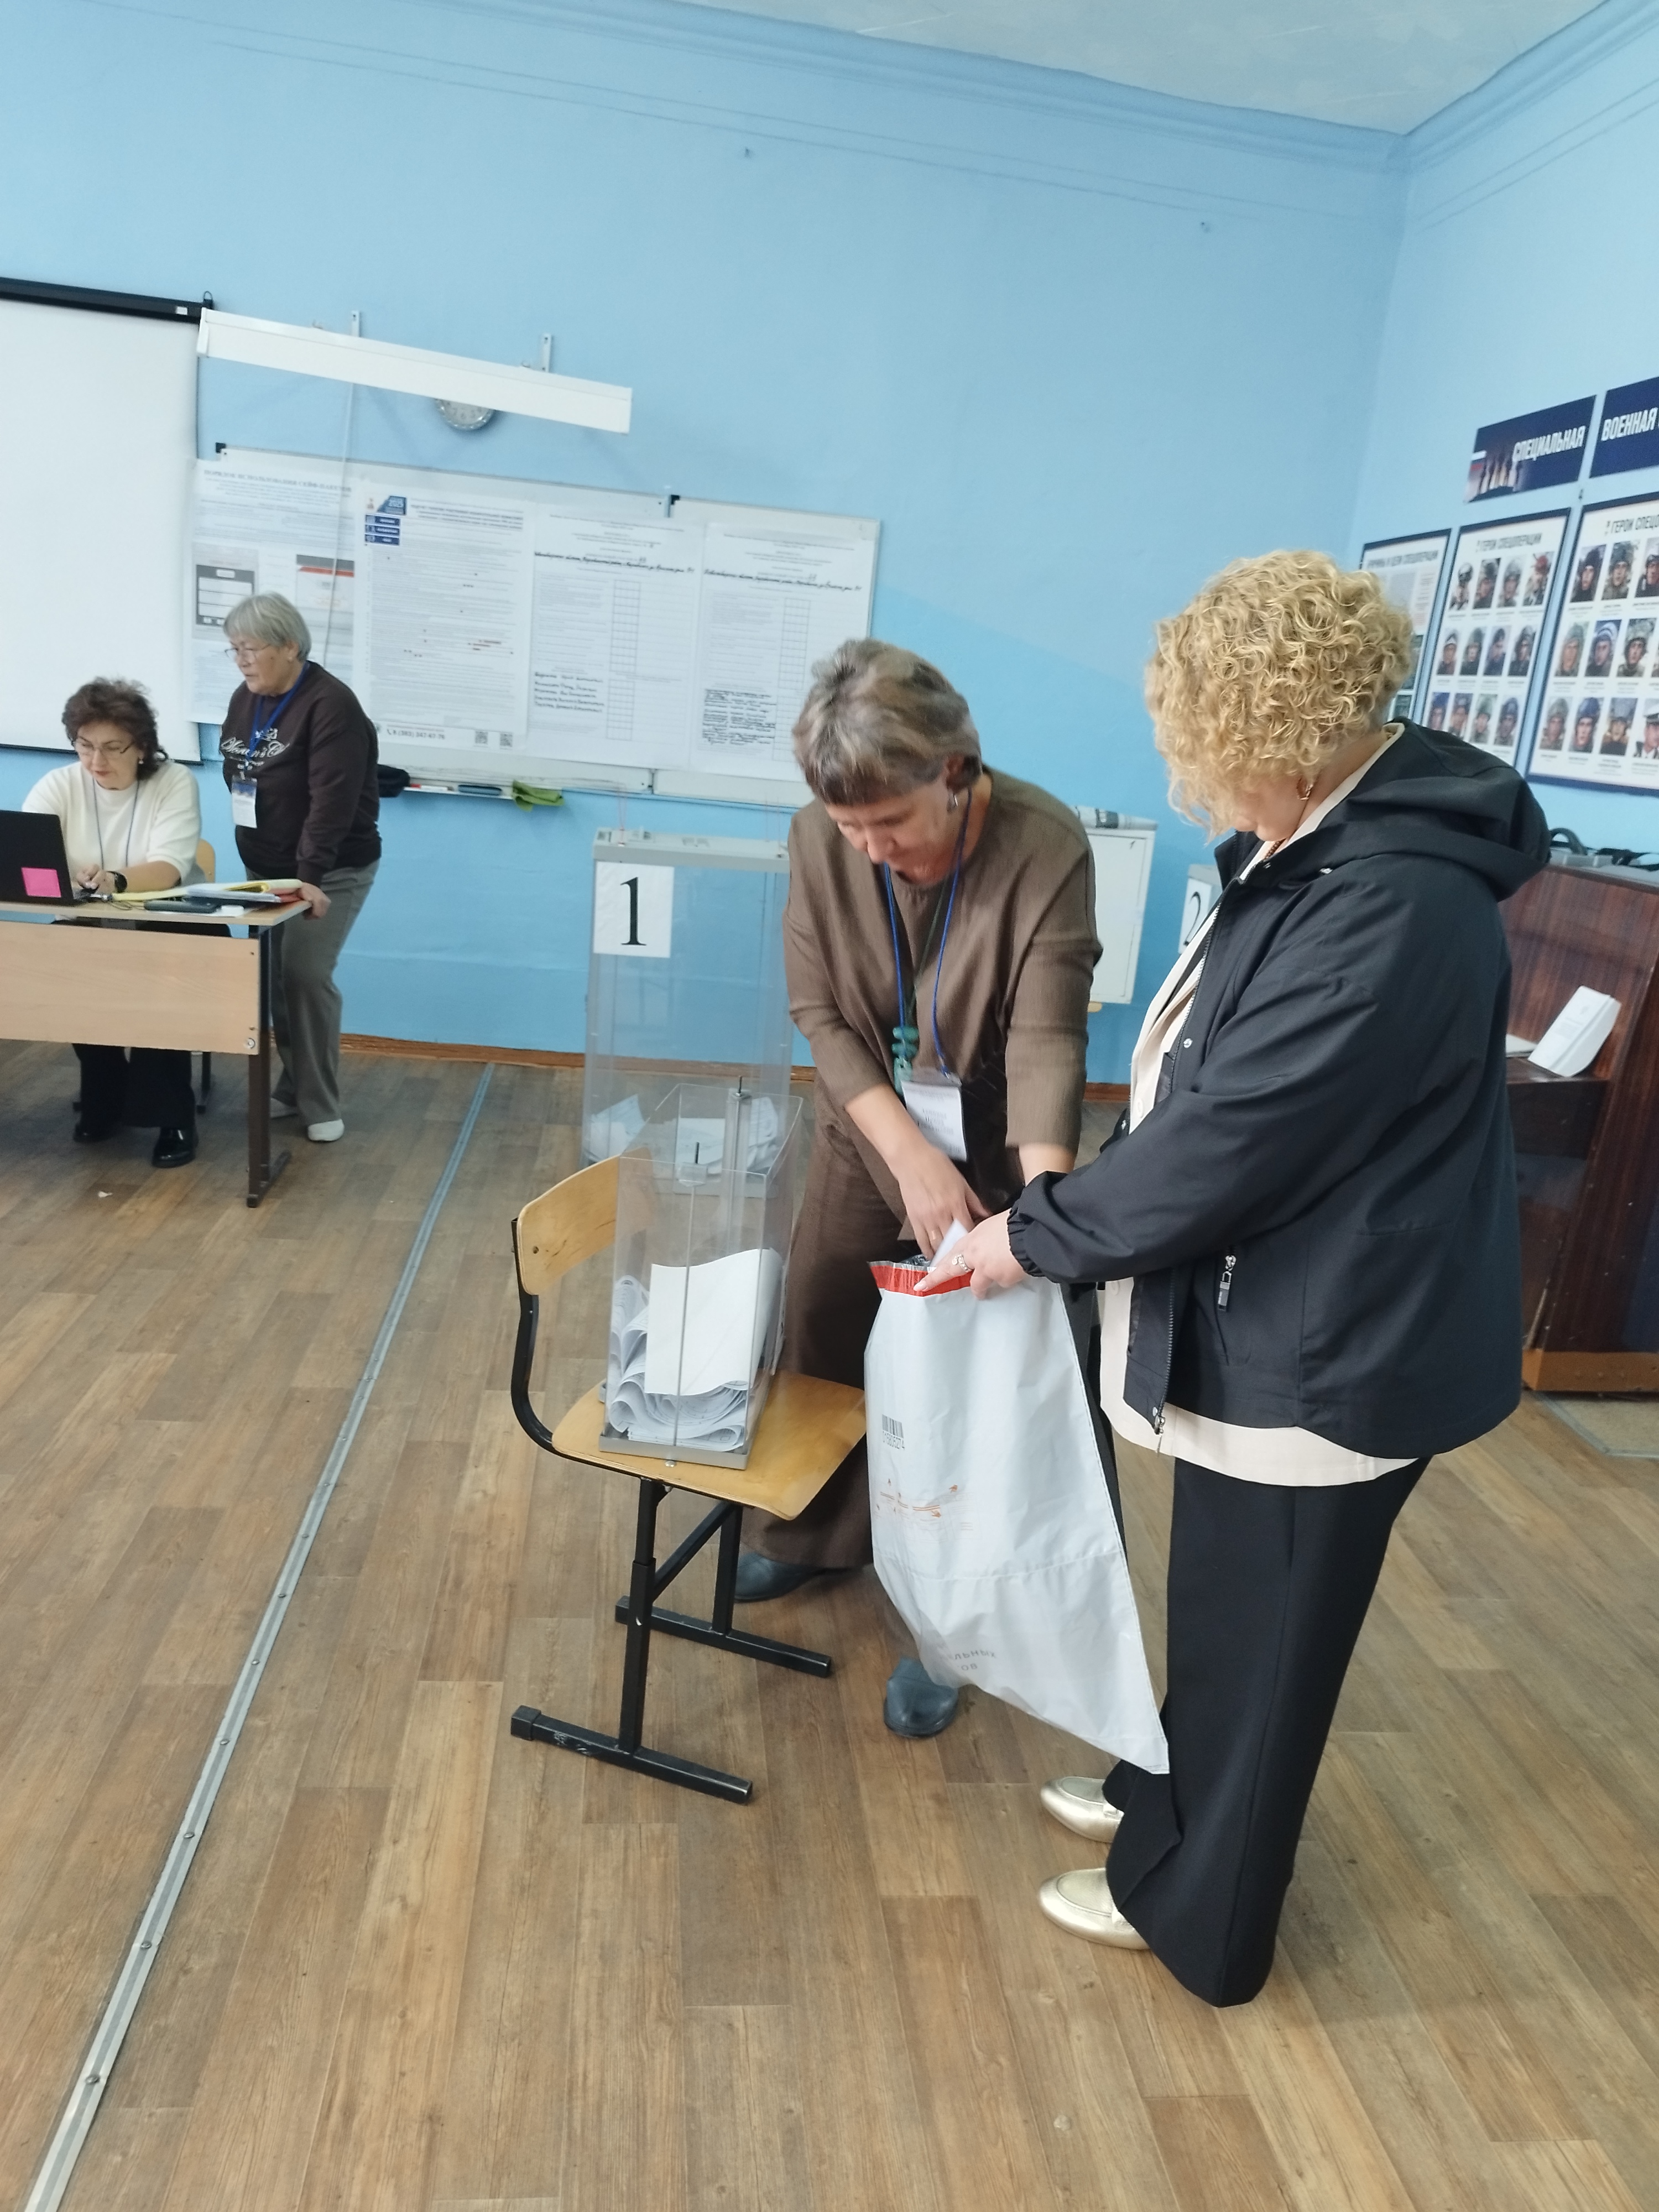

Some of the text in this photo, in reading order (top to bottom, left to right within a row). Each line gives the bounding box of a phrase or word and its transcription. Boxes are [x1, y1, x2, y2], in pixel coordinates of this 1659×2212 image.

[1512, 407, 1658, 461] СПЕЦИАЛЬНАЯ ВОЕННАЯ
[620, 877, 646, 946] 1
